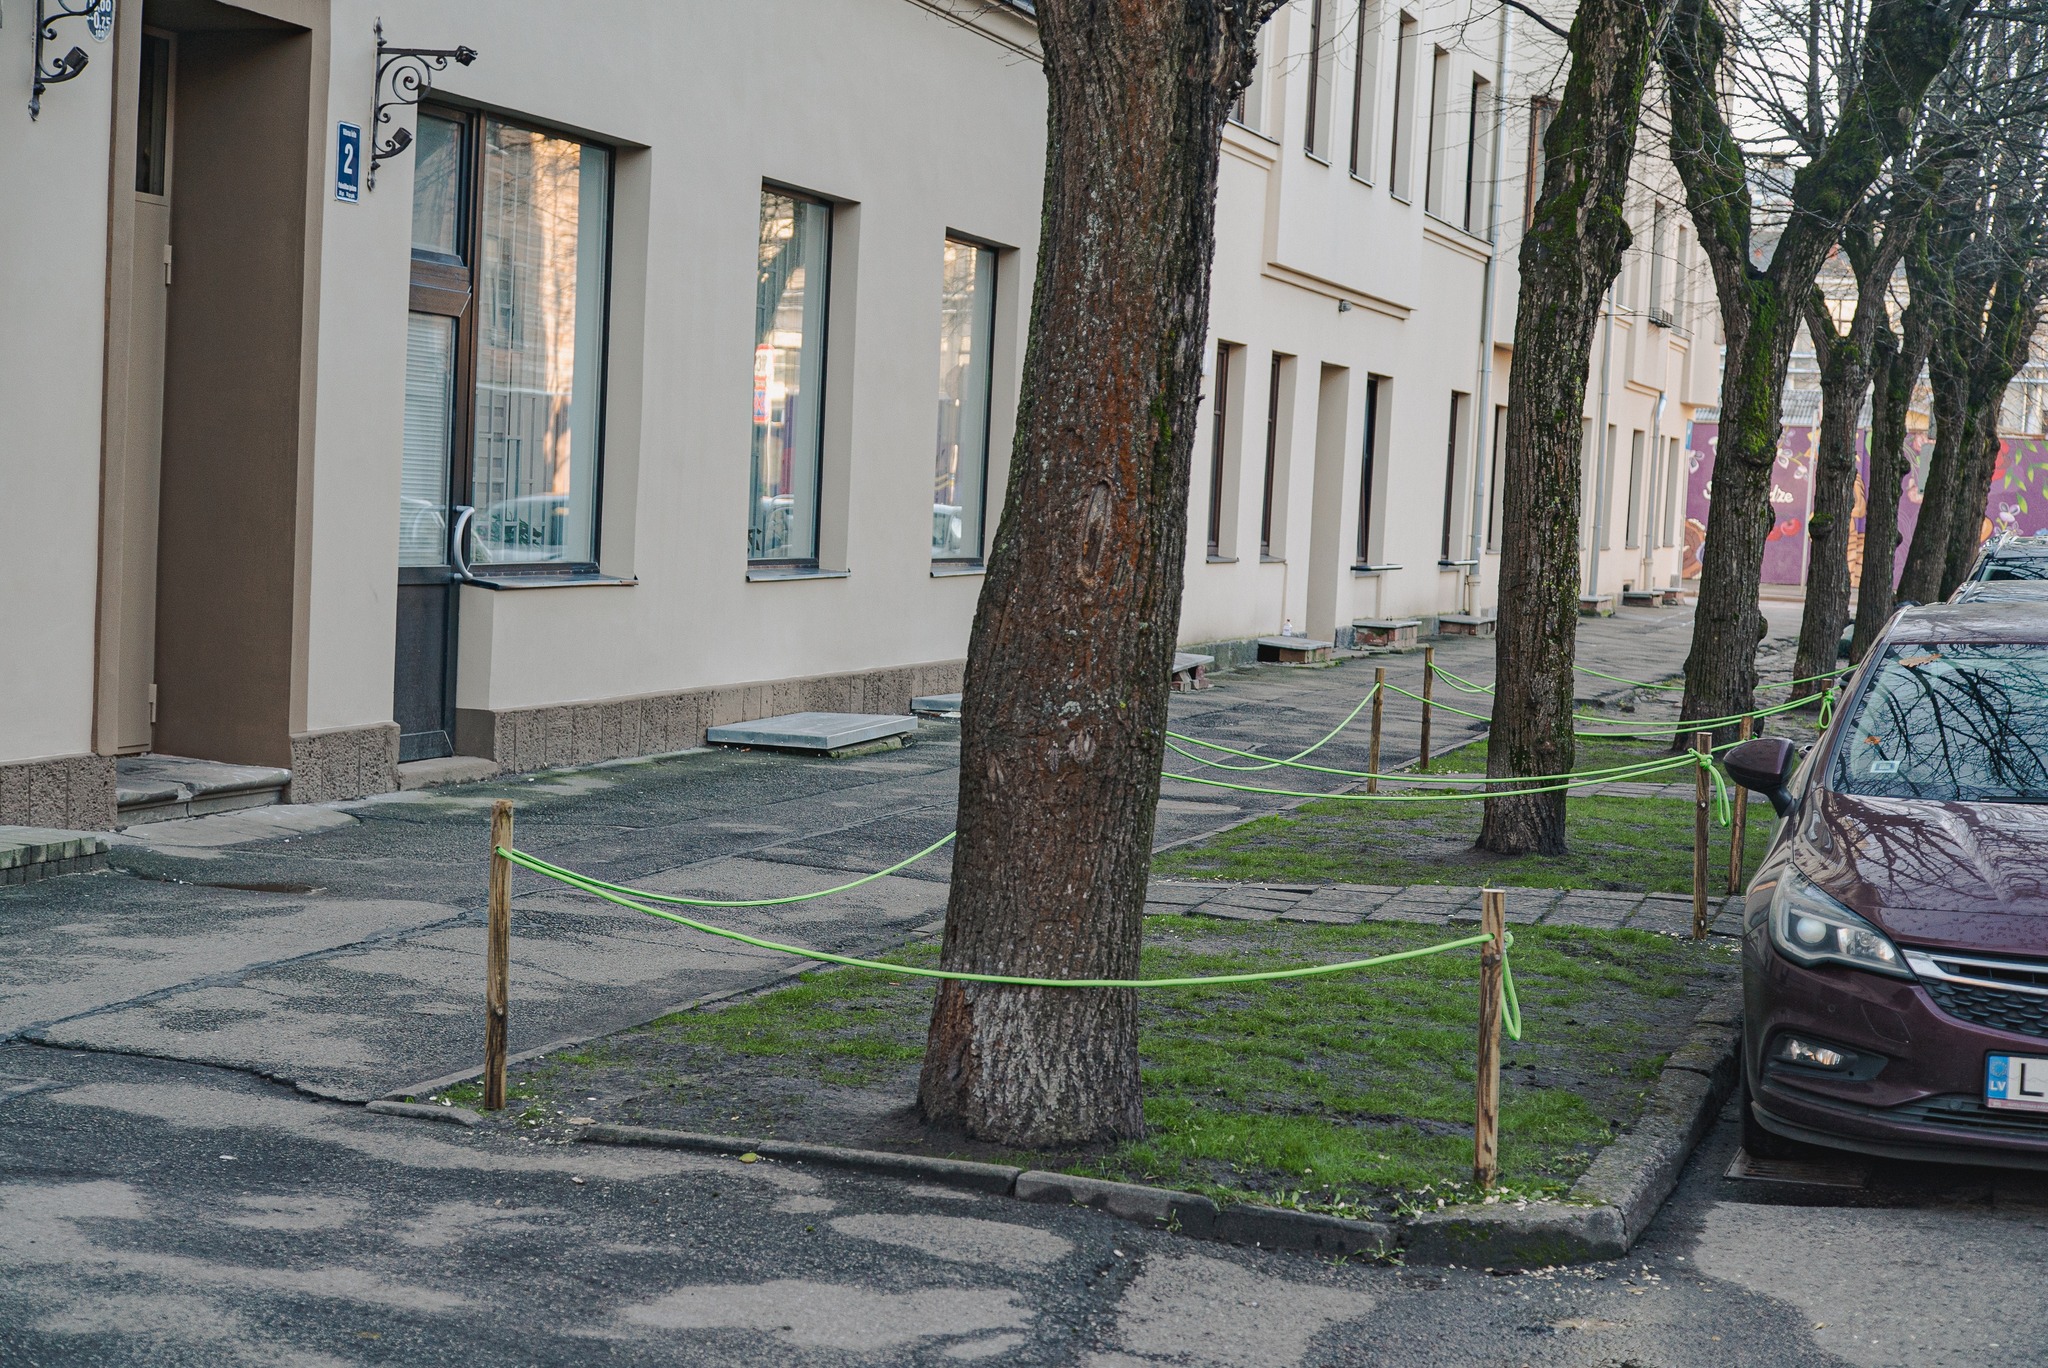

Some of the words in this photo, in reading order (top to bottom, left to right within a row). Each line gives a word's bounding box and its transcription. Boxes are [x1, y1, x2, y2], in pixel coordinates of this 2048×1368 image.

[344, 143, 353, 174] 2
[1990, 1081, 2006, 1091] LV
[2020, 1063, 2044, 1097] L
